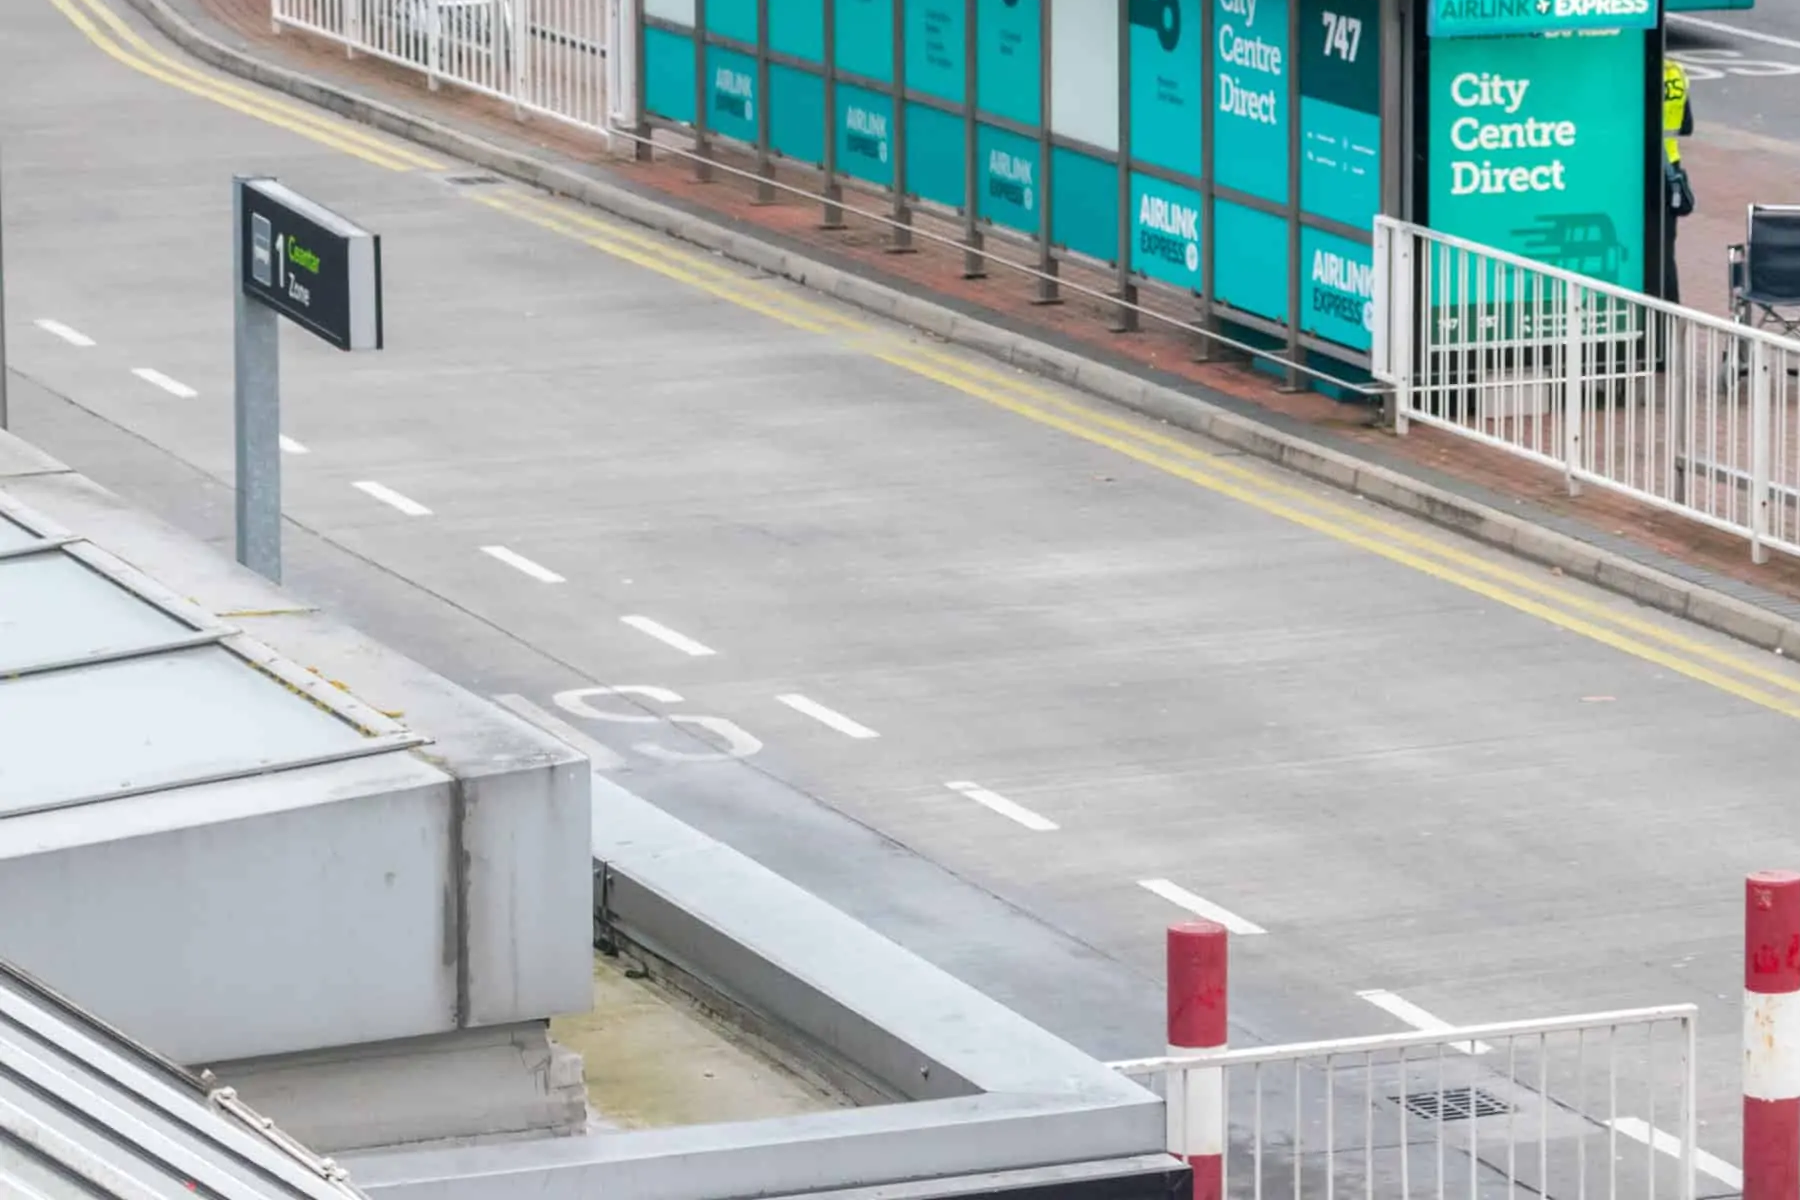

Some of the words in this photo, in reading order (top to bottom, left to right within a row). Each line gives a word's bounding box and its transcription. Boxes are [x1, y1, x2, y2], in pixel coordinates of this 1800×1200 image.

[1219, 28, 1281, 76] Centre
[1322, 11, 1362, 63] 747
[1219, 73, 1277, 125] Direct
[1451, 72, 1530, 113] City
[1451, 117, 1577, 150] Centre
[989, 148, 1032, 185] AIRLINK
[1451, 160, 1566, 195] Direct
[1140, 193, 1198, 242] AIRLINK
[1140, 229, 1185, 266] EXPRESS
[1312, 248, 1374, 296] AIRLINK
[1313, 286, 1362, 325] EXPRESS
